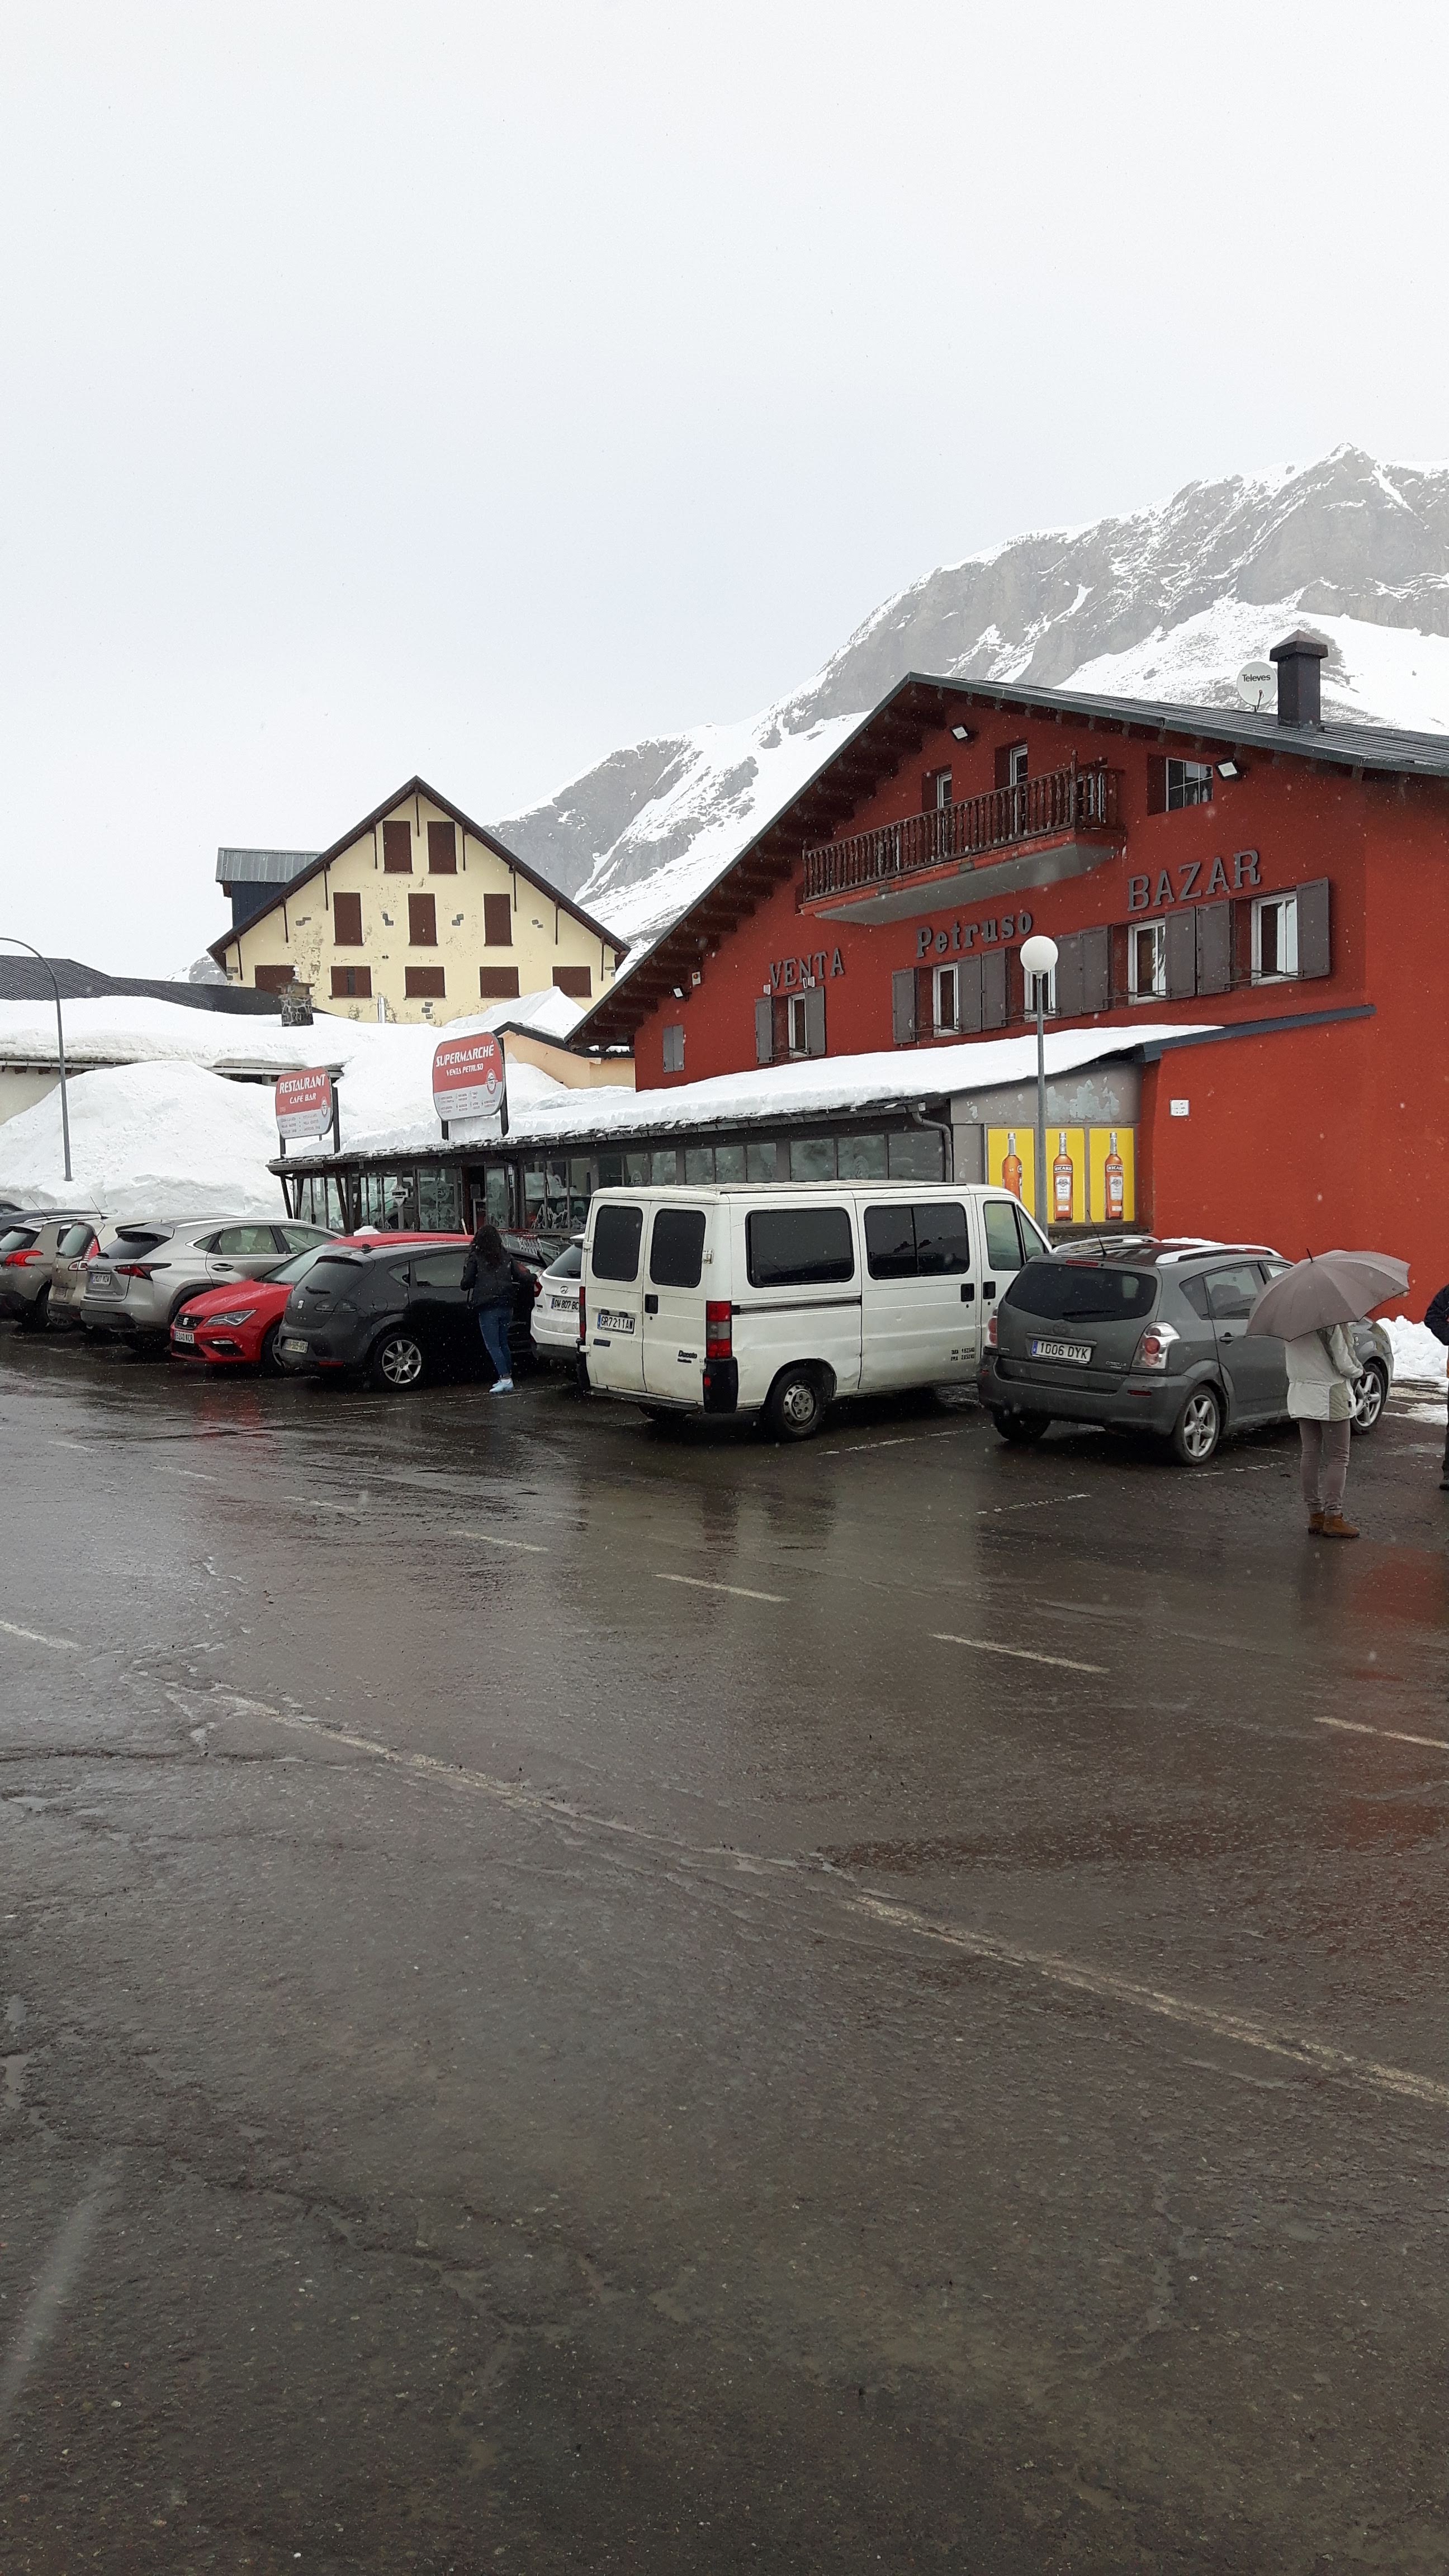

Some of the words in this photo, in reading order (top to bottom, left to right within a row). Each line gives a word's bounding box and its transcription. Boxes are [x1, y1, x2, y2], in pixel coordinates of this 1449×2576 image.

[1242, 674, 1271, 682] Televes
[1126, 849, 1261, 912] BAZAR
[915, 911, 1033, 959] Petruso
[769, 947, 845, 989] VENTA
[435, 1040, 495, 1067] SUPERMARCHÉ
[279, 1073, 326, 1094] RESTAURANT
[289, 1092, 304, 1105] CAFÉ
[304, 1092, 316, 1102] BAR
[1040, 1342, 1065, 1356] 1006
[1067, 1346, 1088, 1360] DYK
